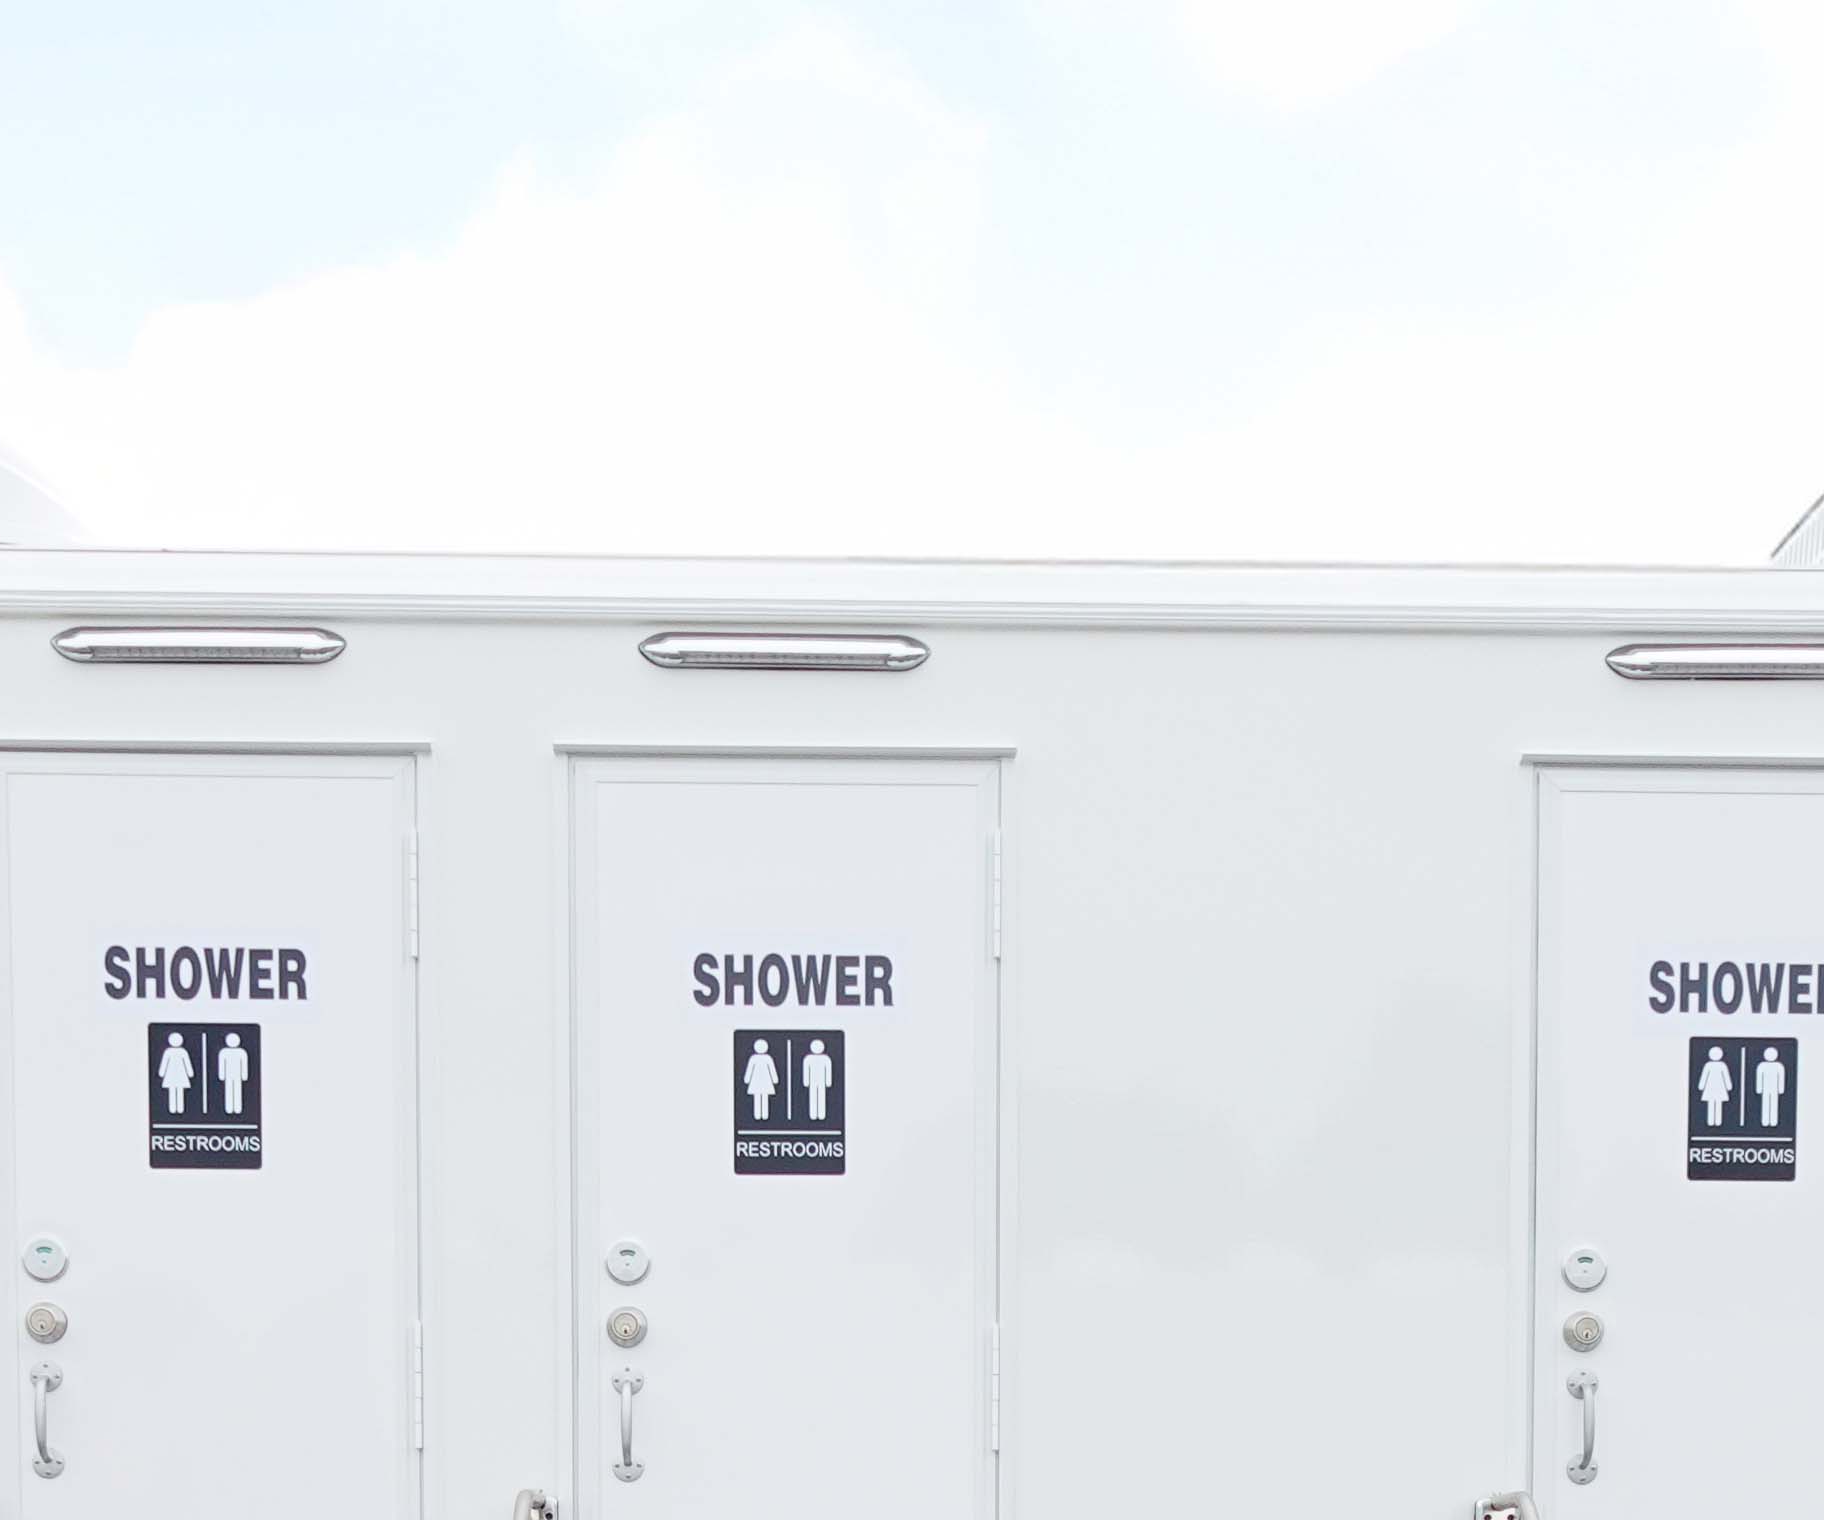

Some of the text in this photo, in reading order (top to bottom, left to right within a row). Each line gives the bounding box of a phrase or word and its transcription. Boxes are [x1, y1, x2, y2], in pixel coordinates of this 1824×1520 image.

[104, 945, 307, 1001] SHOWER
[693, 952, 893, 1007] SHOWER
[152, 1135, 261, 1151] RESTROOMS
[736, 1142, 844, 1157] RESTROOMS
[1689, 1148, 1795, 1163] RESTROOMS
